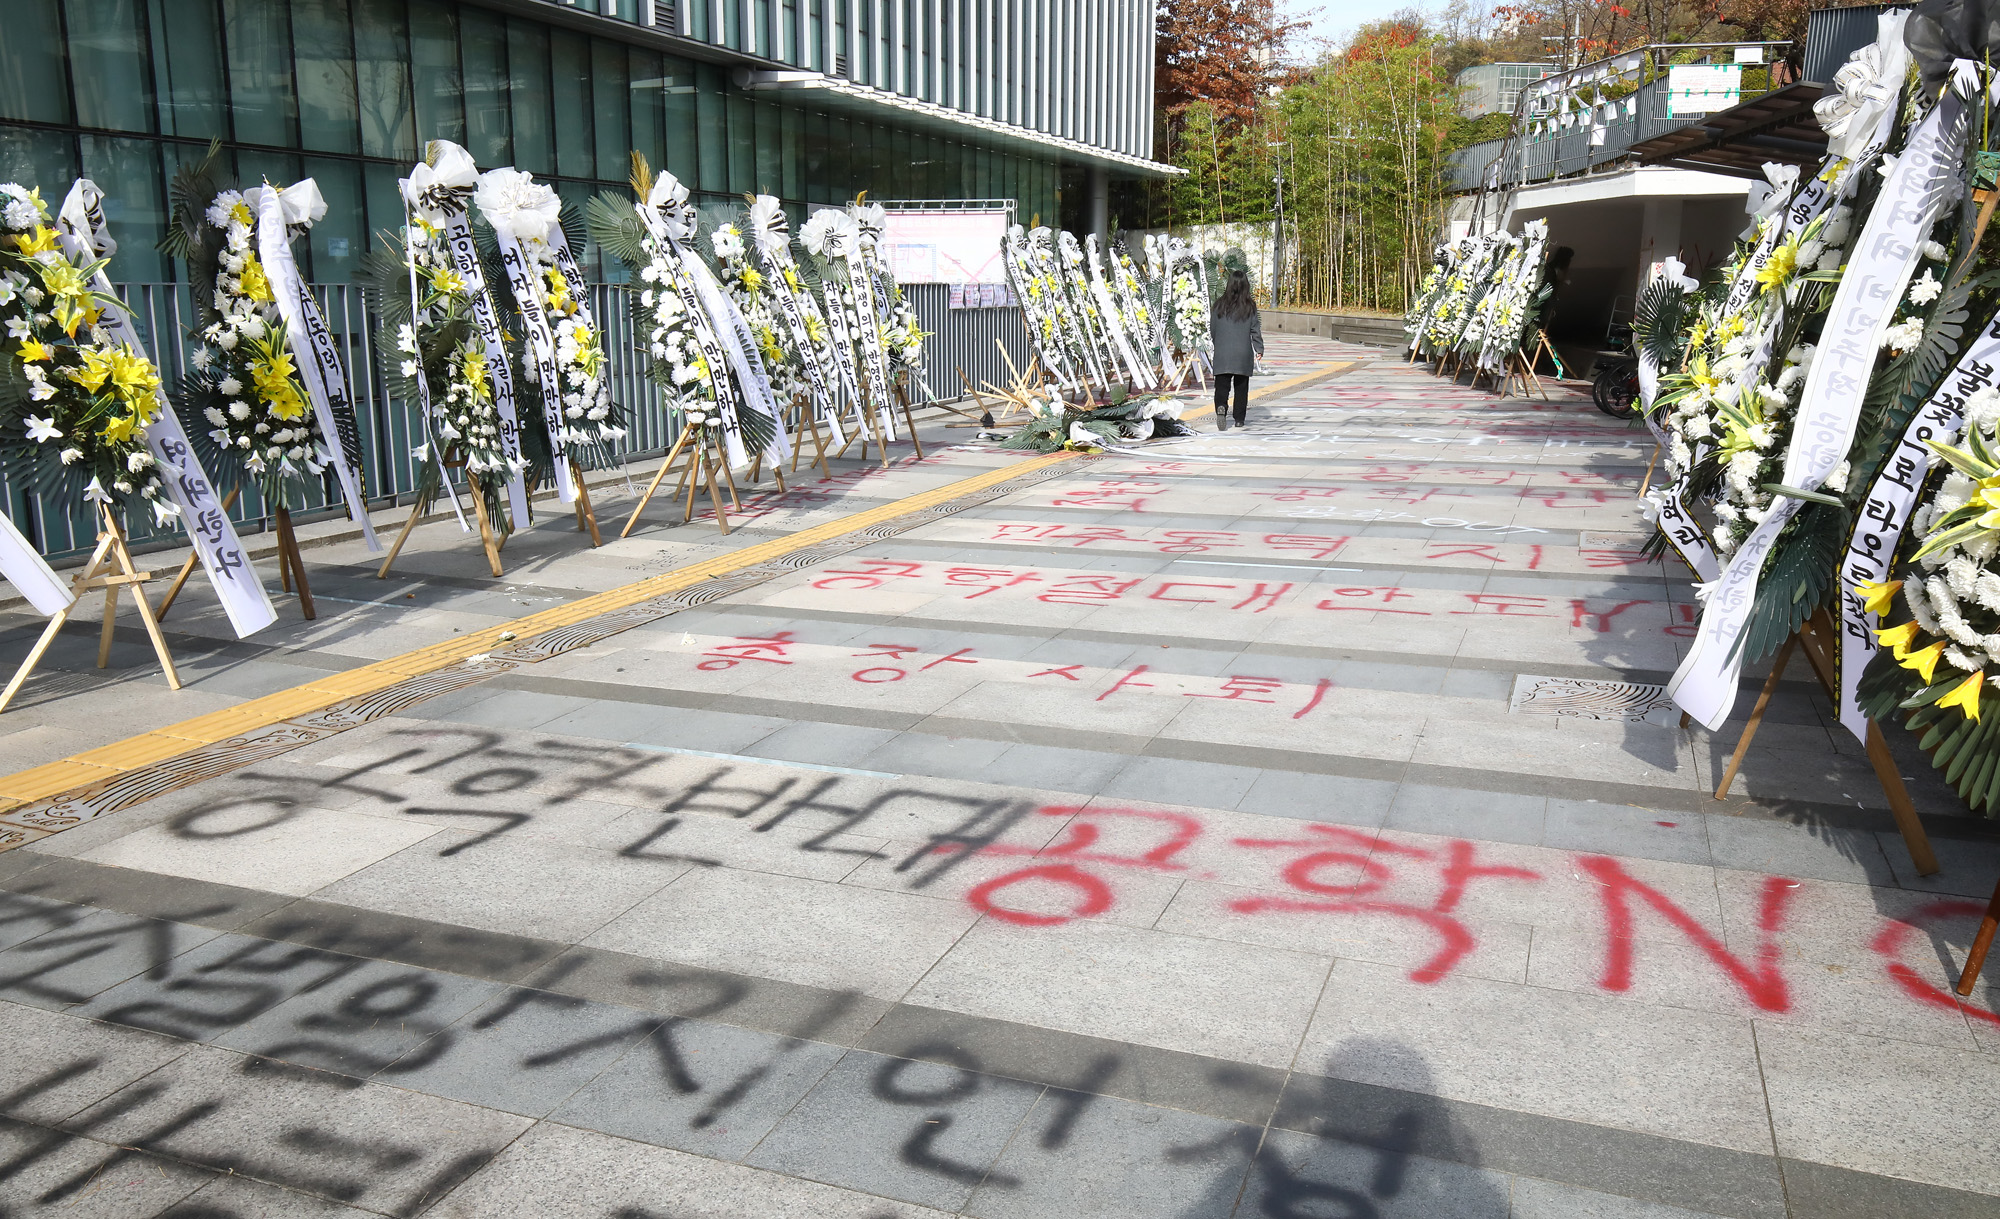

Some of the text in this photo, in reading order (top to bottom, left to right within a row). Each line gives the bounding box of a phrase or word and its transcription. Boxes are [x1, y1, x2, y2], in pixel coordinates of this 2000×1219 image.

[450, 224, 478, 280] 공학
[491, 353, 514, 407] 결사
[503, 247, 549, 347] 여자들이
[763, 257, 802, 331] 여자들이
[703, 341, 739, 437] 만만하냐
